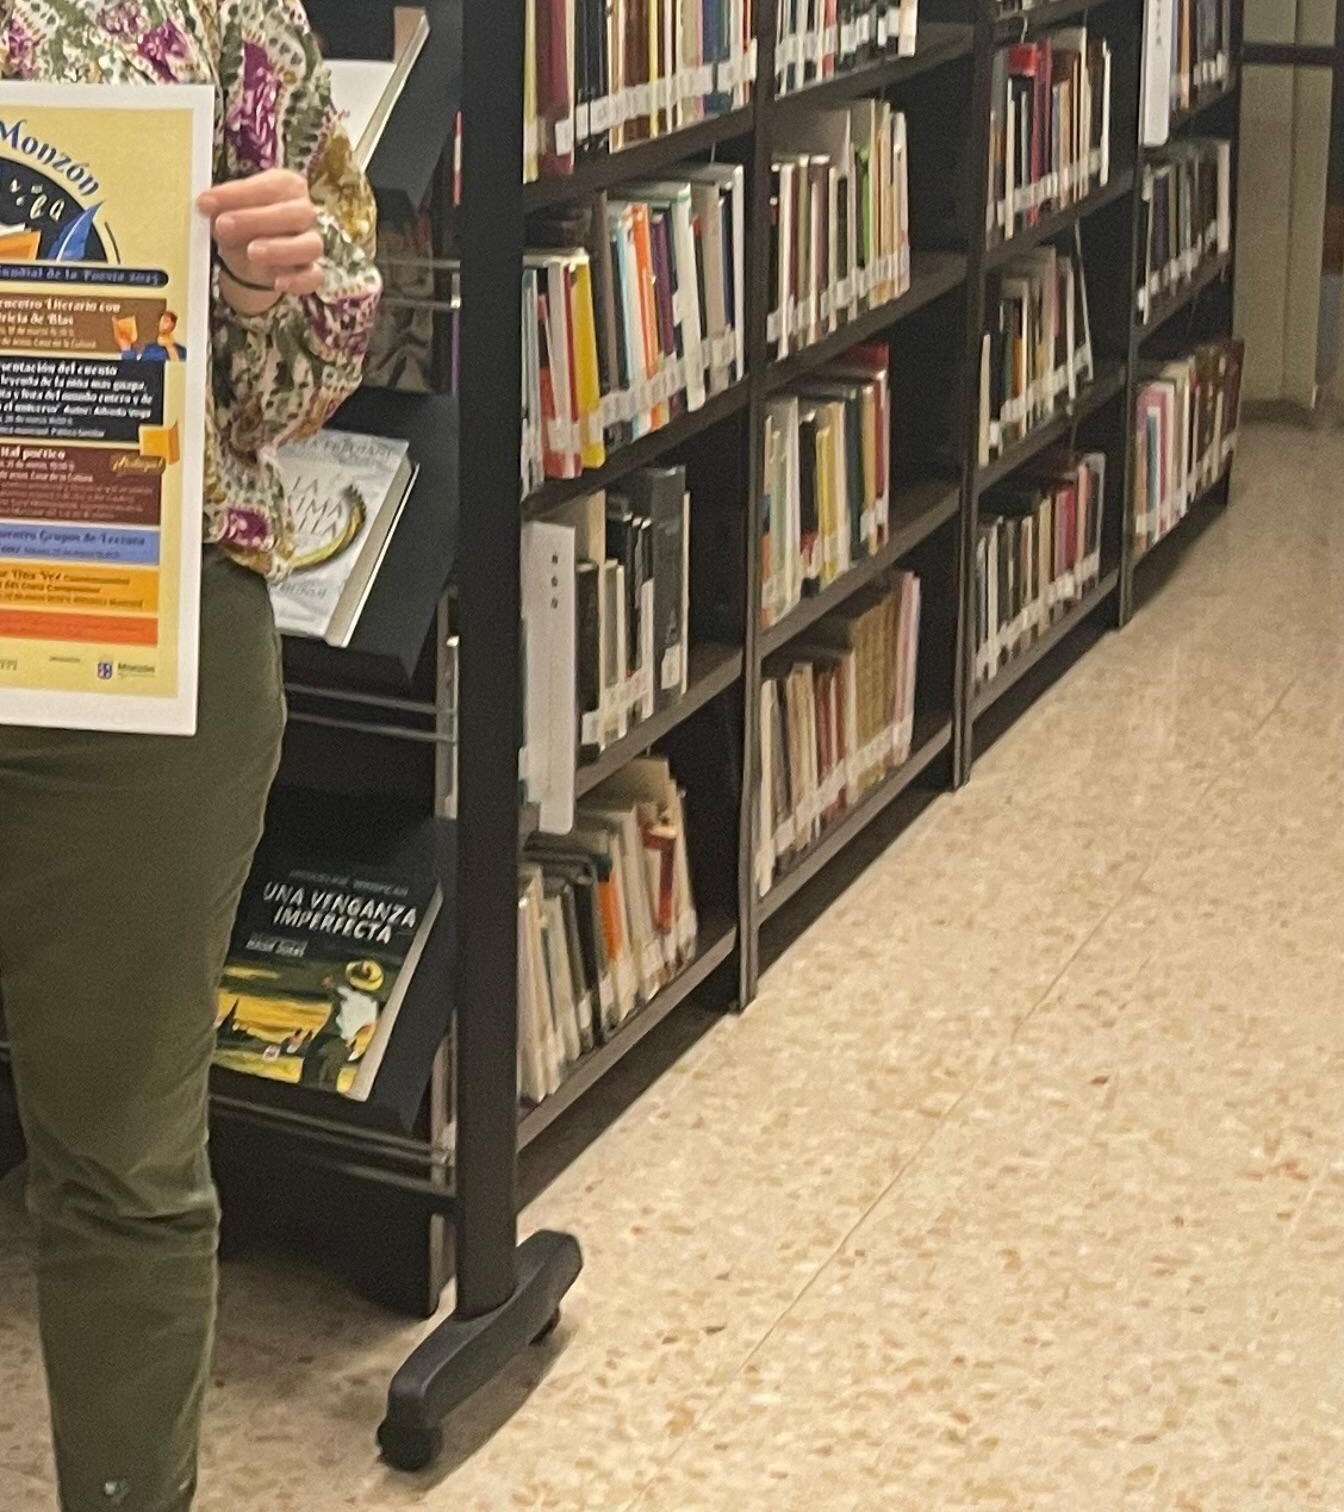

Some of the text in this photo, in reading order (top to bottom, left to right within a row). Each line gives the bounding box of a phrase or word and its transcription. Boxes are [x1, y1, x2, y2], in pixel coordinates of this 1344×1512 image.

[30, 312, 43, 324] de
[57, 360, 75, 374] del
[264, 881, 305, 906] UNA
[311, 889, 417, 928] VENGANZA
[273, 905, 392, 944] IMPERFECTA
